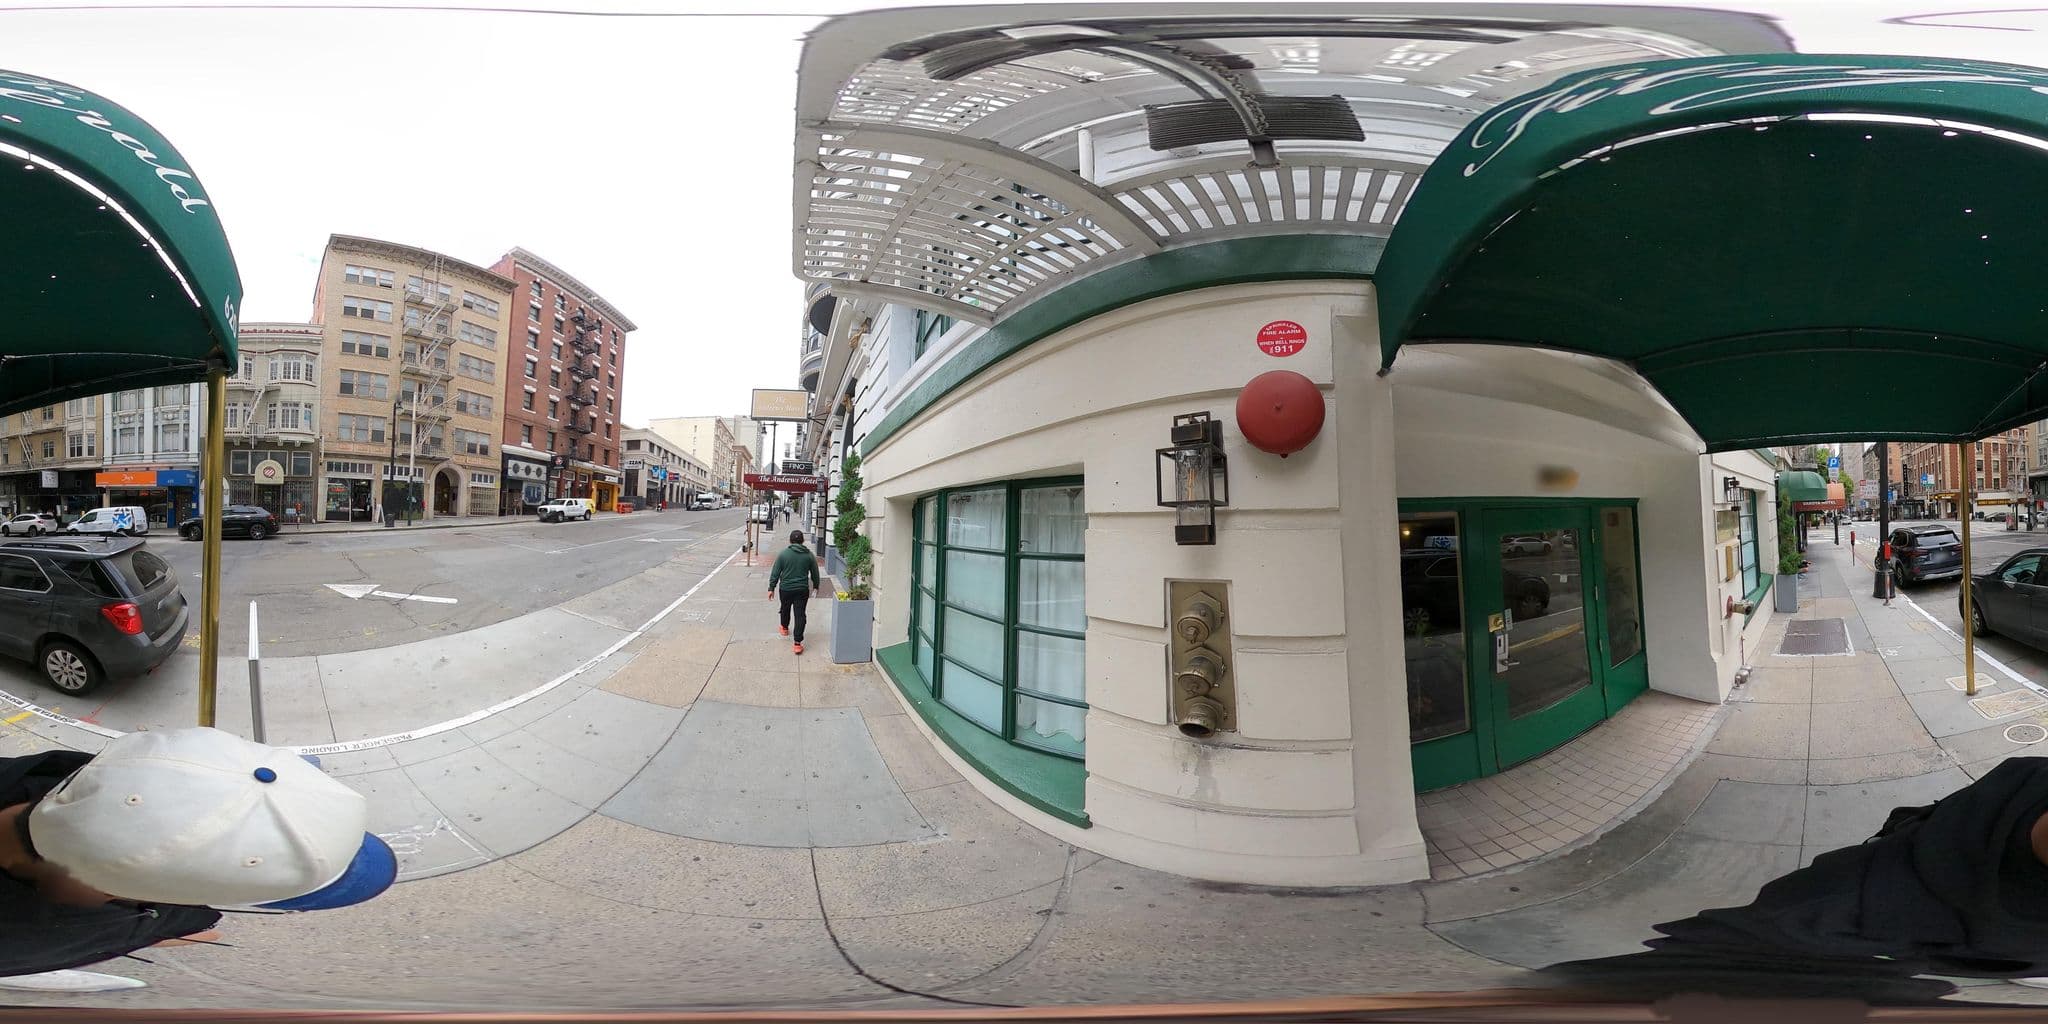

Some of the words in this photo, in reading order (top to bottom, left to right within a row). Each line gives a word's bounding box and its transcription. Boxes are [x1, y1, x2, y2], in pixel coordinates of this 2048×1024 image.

[1274, 345, 1293, 353] 911
[758, 475, 770, 483] The
[771, 475, 799, 484] Andrews
[800, 476, 818, 485] Hotel
[351, 733, 412, 750] PASSENGER
[301, 742, 348, 755] LOADING
